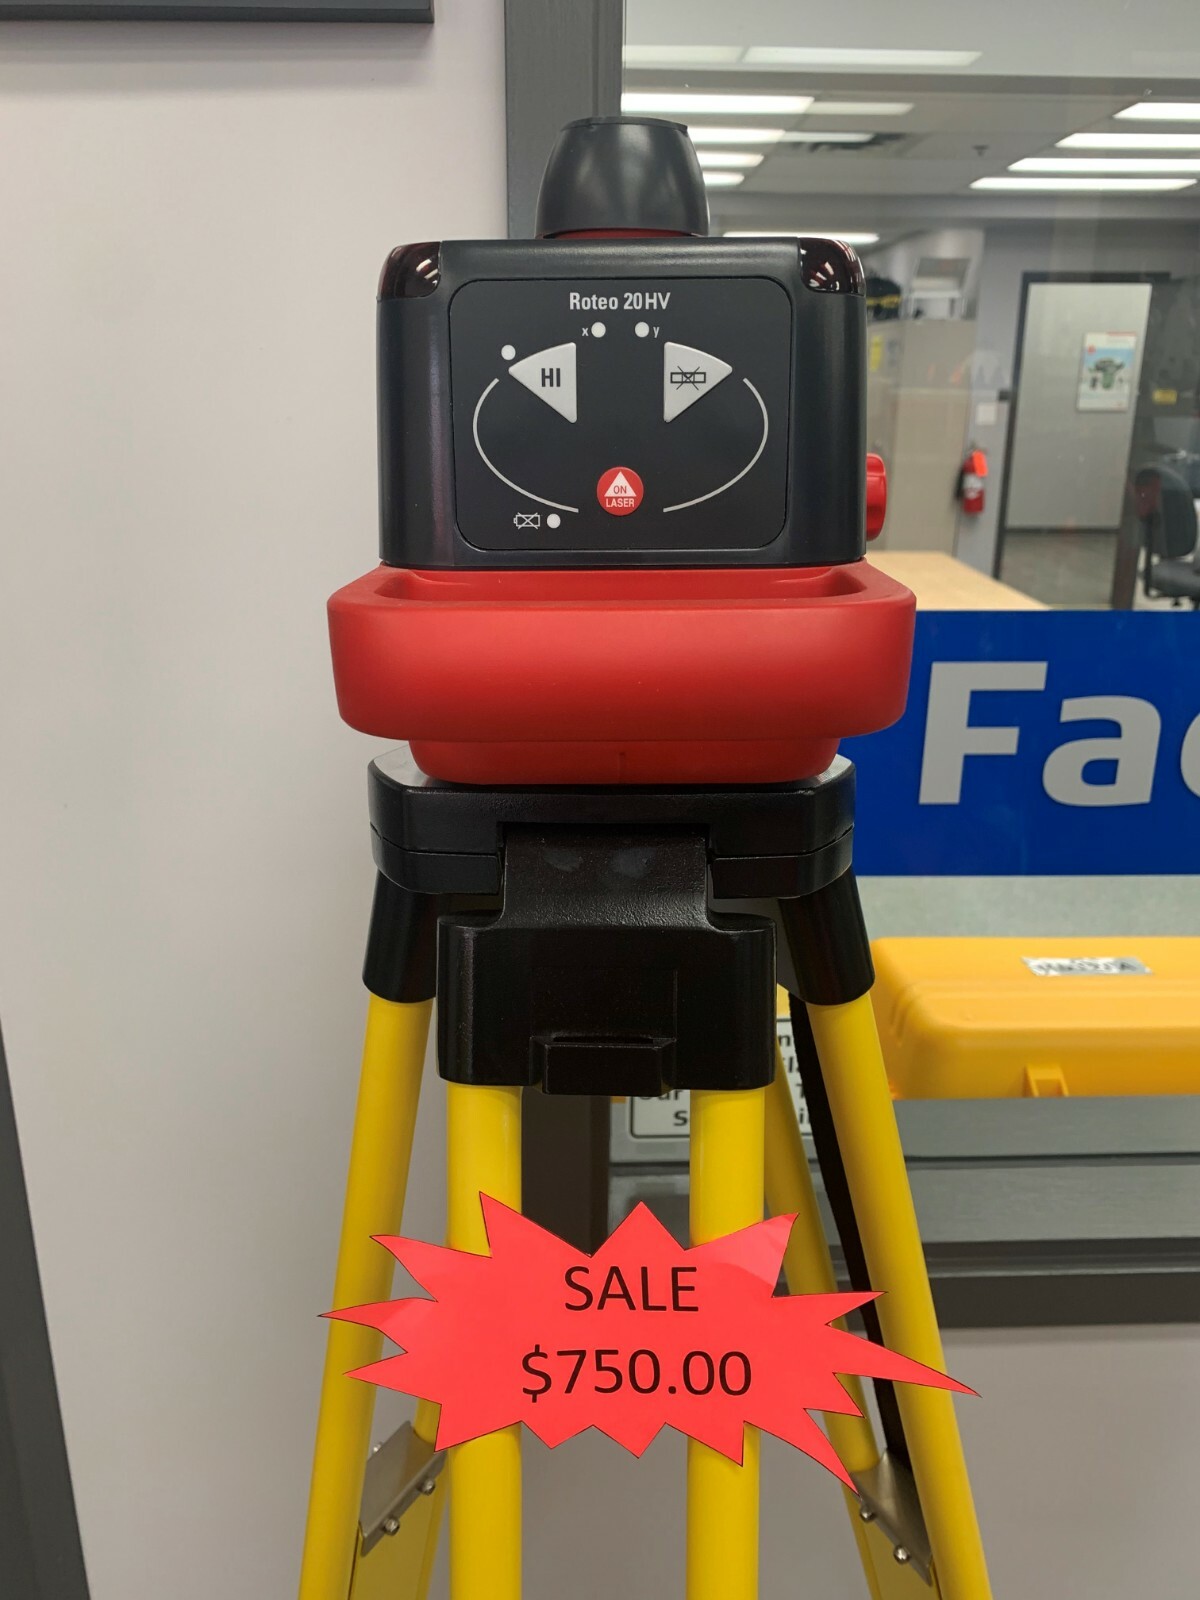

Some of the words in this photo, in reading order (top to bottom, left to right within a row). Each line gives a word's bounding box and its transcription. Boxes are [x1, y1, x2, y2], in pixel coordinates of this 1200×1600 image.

[569, 292, 619, 310] Roteo
[541, 367, 561, 388] HI
[613, 485, 627, 495] ON
[605, 498, 635, 508] LASER
[563, 1265, 700, 1313] SALE
[521, 1343, 753, 1404] $750.00
